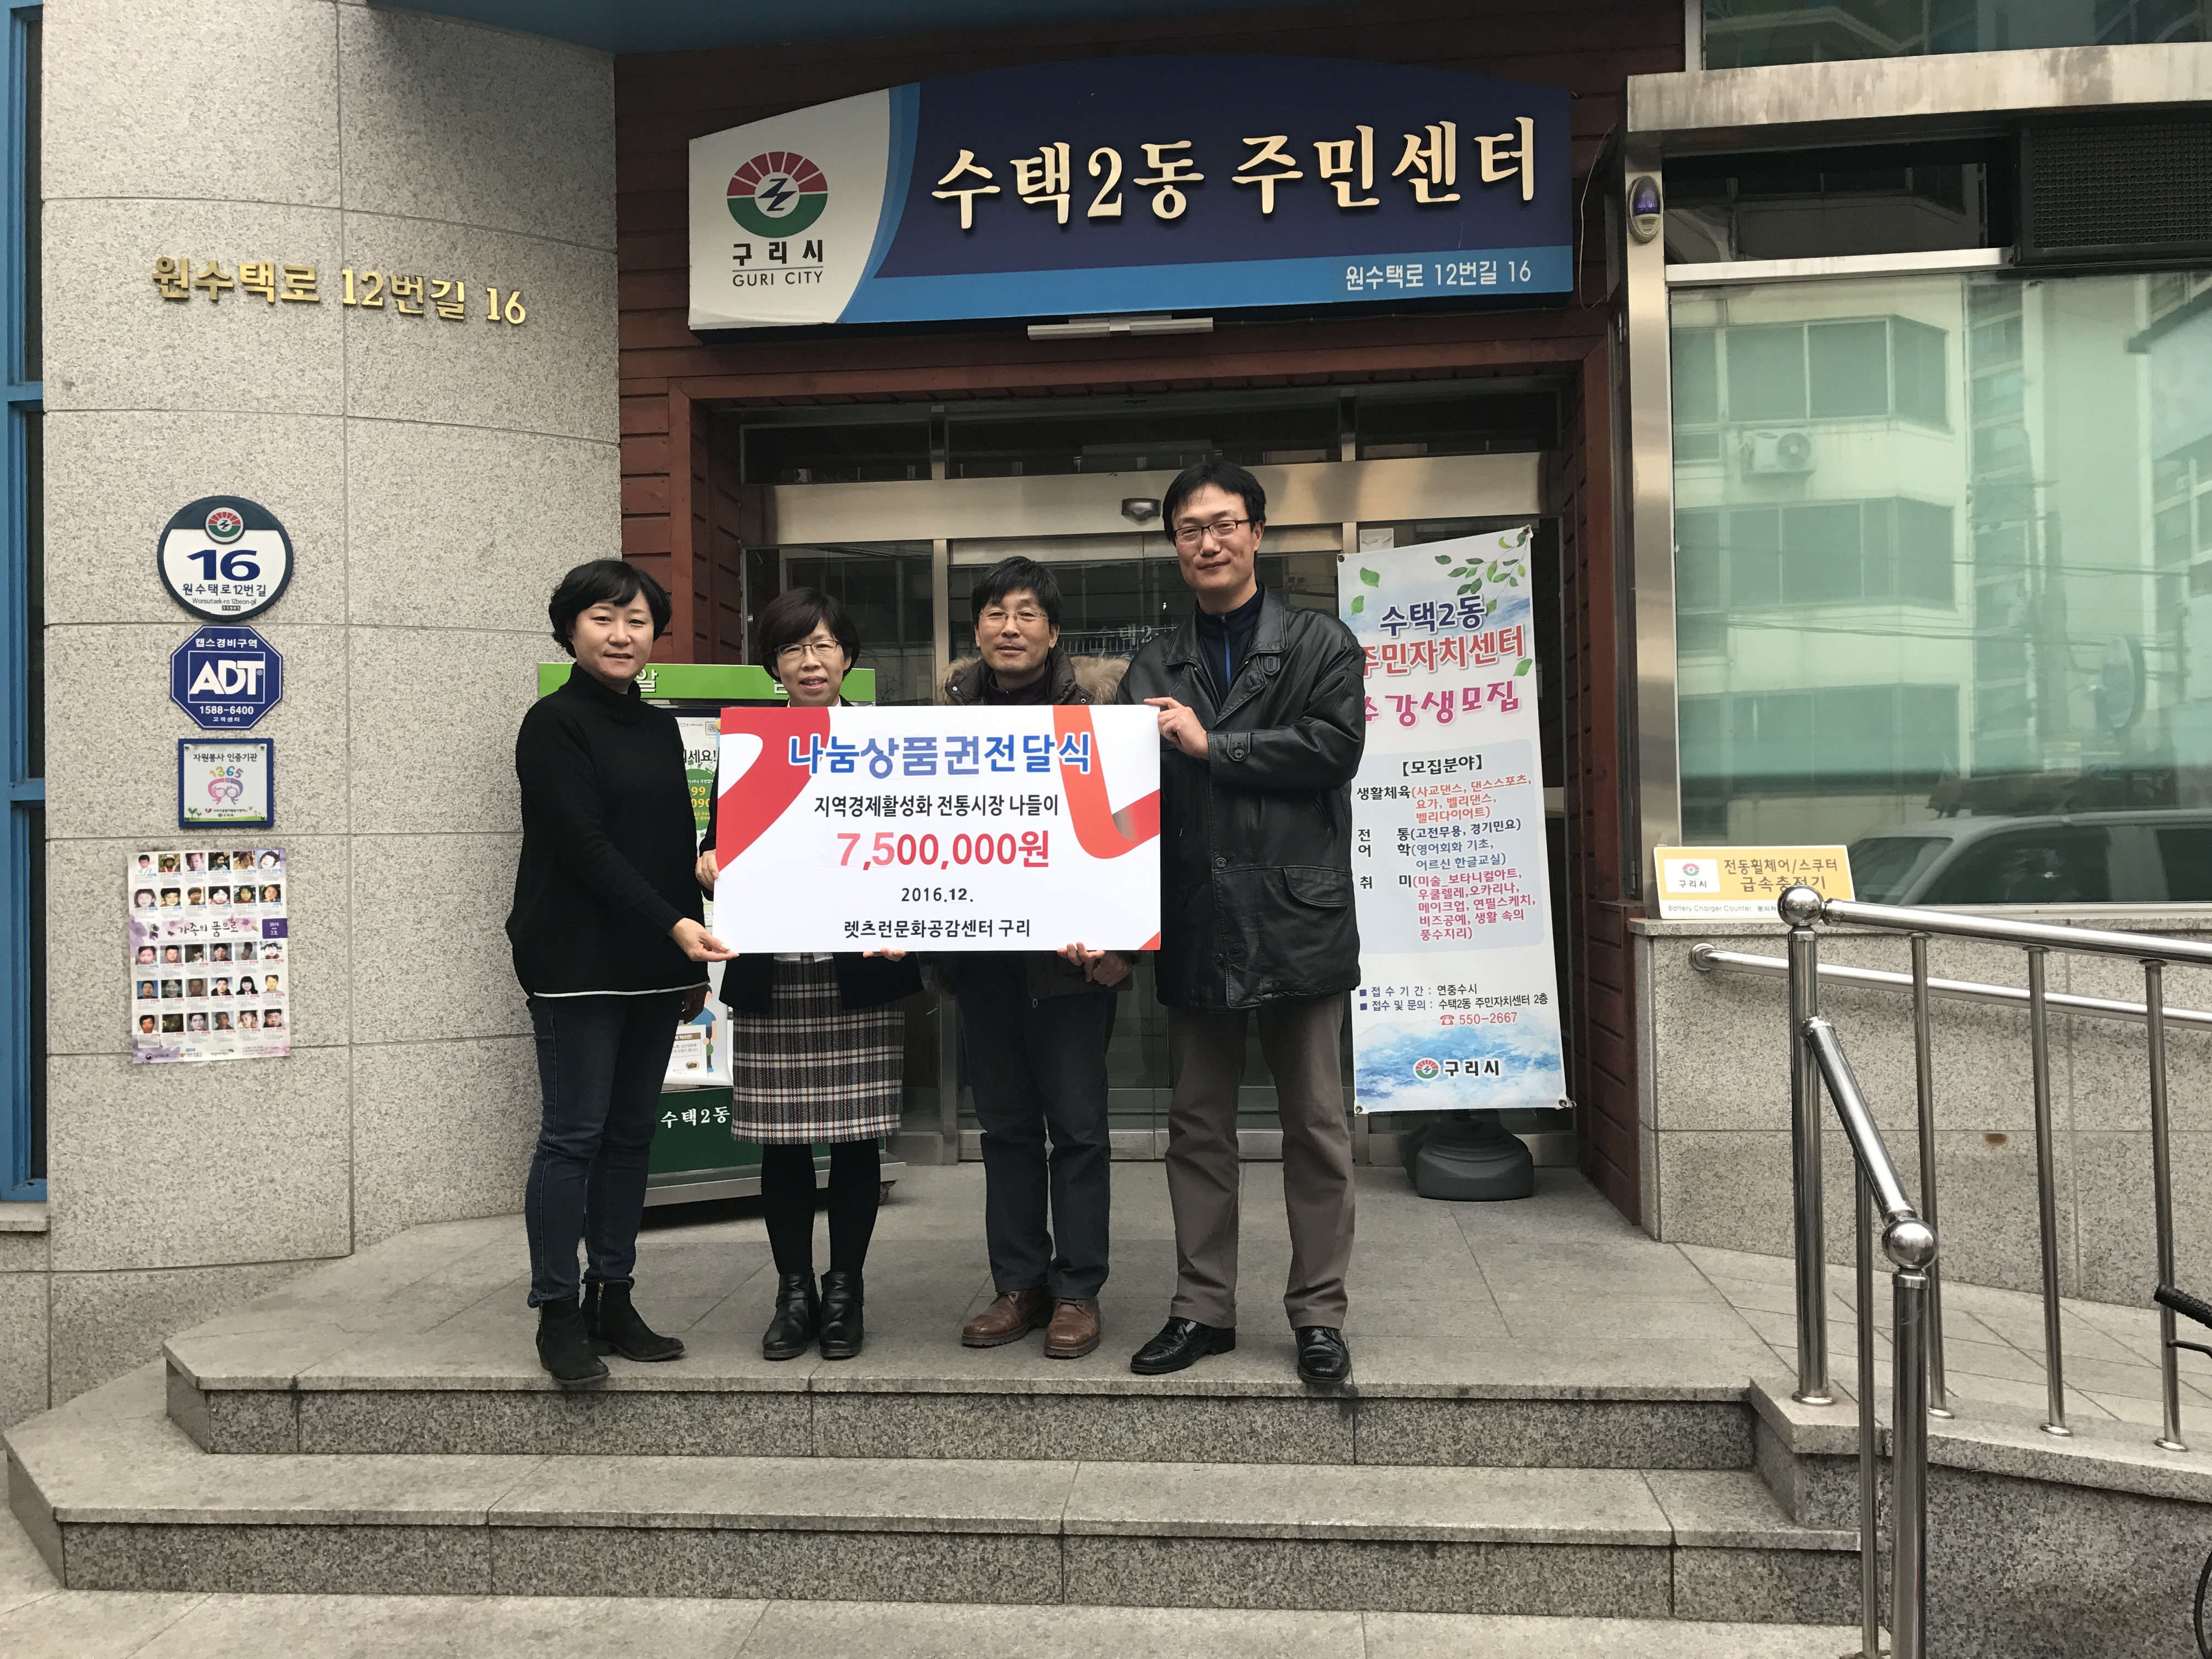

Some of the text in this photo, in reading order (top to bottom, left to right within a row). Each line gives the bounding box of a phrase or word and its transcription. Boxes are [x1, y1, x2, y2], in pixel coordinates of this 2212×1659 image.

[932, 116, 1534, 229] 수택2동 주민센터
[732, 239, 823, 267] 구리시
[732, 270, 823, 287] GURI CITY
[1346, 260, 1532, 291] 원수택로 12번길 16
[152, 256, 527, 325] 원수택로 12번길 16
[187, 549, 261, 582] 16
[1380, 595, 1485, 637] 수택2동
[195, 638, 258, 648] 캡스경비구역
[1363, 625, 1523, 676] 주민자치센터
[189, 660, 265, 695] ADT
[200, 706, 254, 715] 1588-6400
[193, 753, 258, 763] 자원봉사 인증기관
[791, 734, 1090, 779] 나눔상품권전달식
[1471, 774, 1532, 792] 댄스스포츠,
[814, 794, 1059, 818] 지역경제활성화 전통시장 나들이
[1415, 793, 1497, 810] 요가, 벨리댄스,
[1415, 806, 1491, 824] 벨리다이어트)
[1470, 818, 1521, 835] 경기민요)
[837, 830, 1049, 871] 7,500,000원
[1467, 839, 1494, 850] 기초,
[1416, 853, 1506, 871] 어르신 한글교실)
[1679, 880, 1707, 888] 구리시
[1418, 895, 1536, 914] 메이크업, 연필스케치,
[1419, 909, 1525, 928] 비즈공예, 생활 속의
[178, 921, 239, 938] 가족의 품으로
[844, 919, 1030, 939] 렛츠런문화공감센터 구리
[1420, 927, 1473, 941] 풍수지리)
[1437, 983, 1477, 996] 연중수시
[1372, 1000, 1390, 1012] 접수
[1394, 1000, 1403, 1011] 및
[1407, 1000, 1426, 1011] 문의
[1438, 997, 1471, 1010] 수택2동
[1475, 994, 1530, 1009] 주민자치센터
[1534, 992, 1549, 1005] 2층
[1459, 1012, 1517, 1025] 550-2667
[1444, 1060, 1499, 1077] 구리시
[660, 1106, 731, 1128] 수택2동
